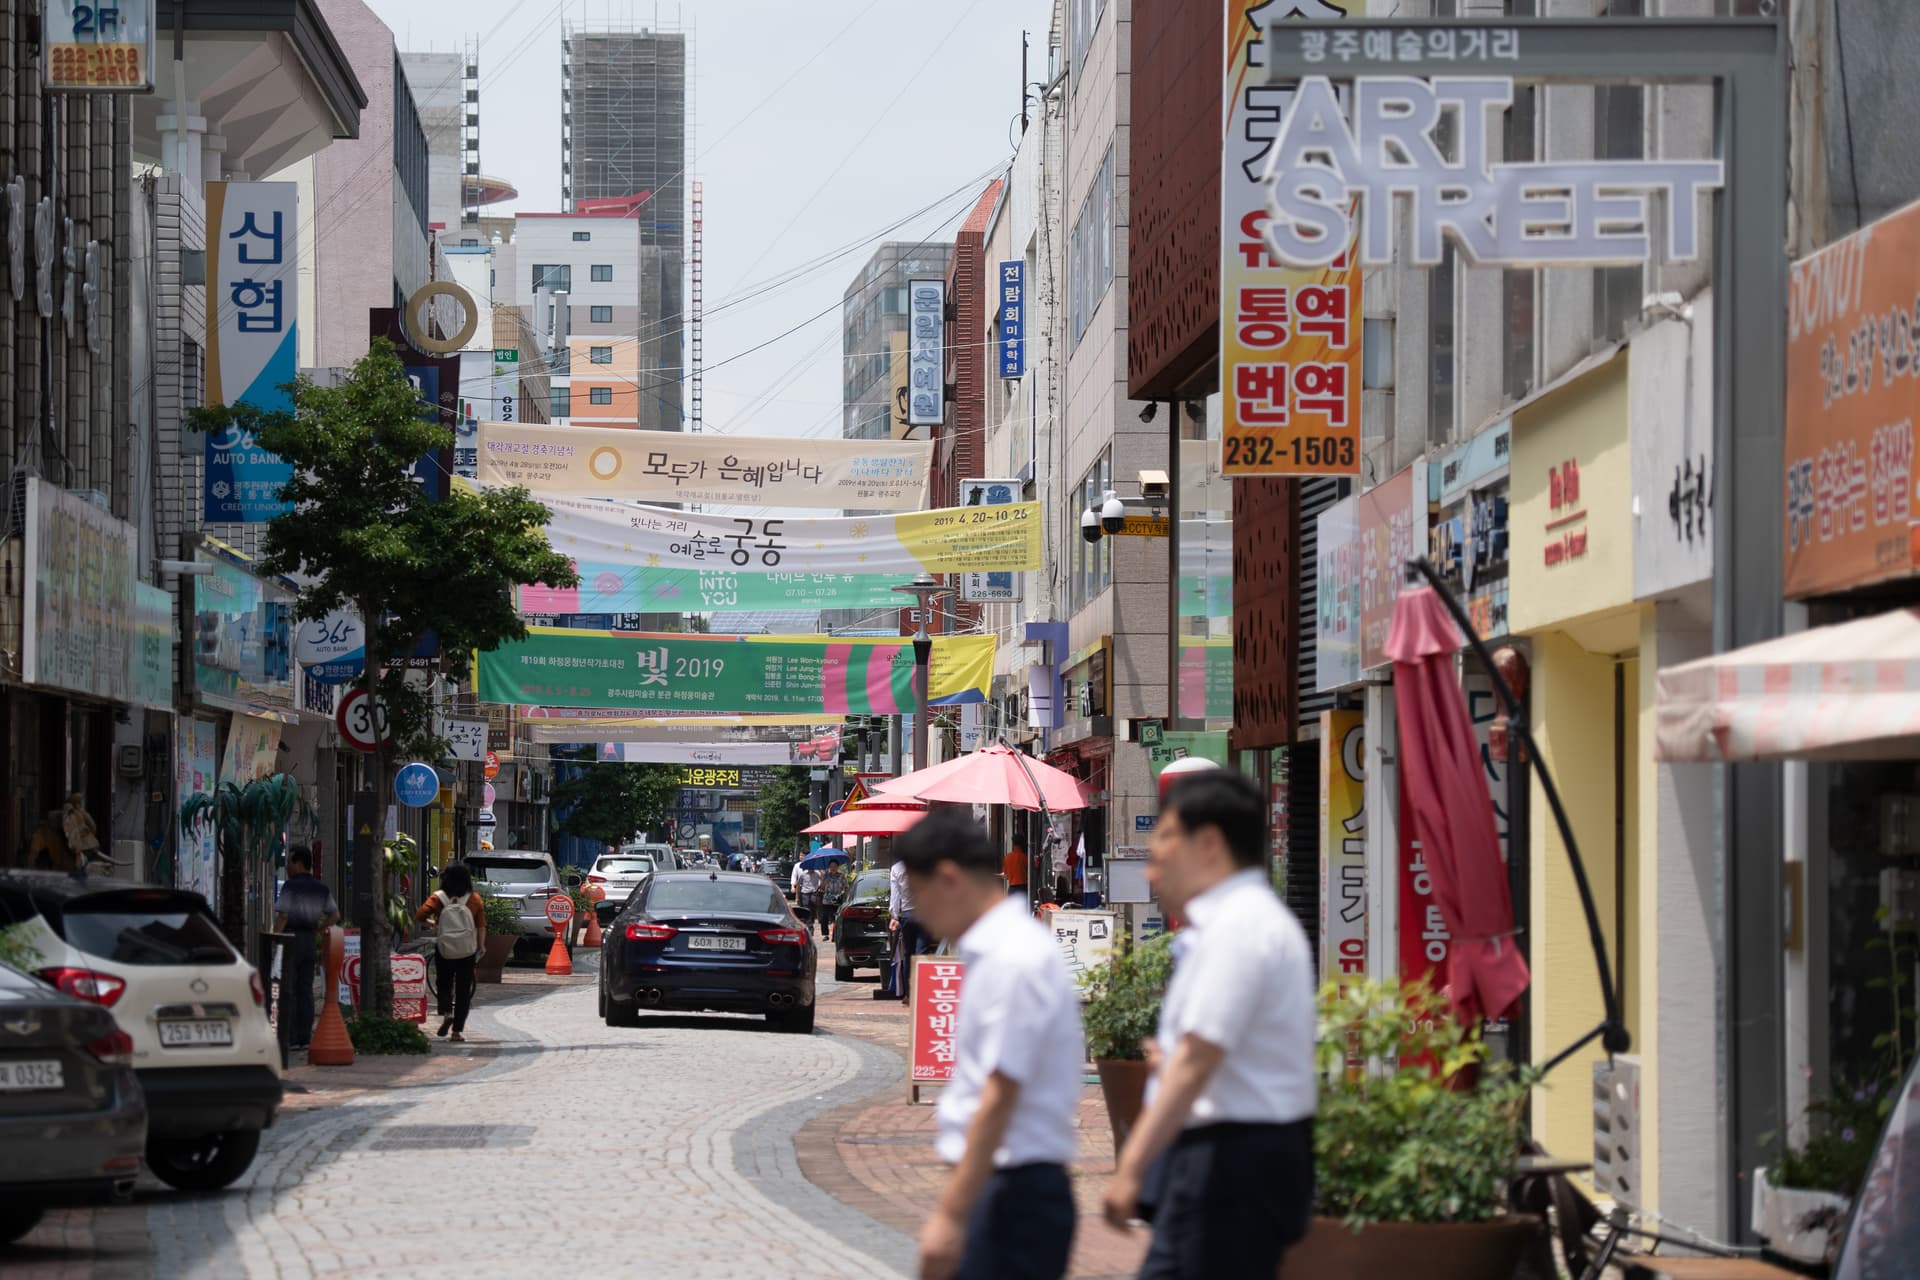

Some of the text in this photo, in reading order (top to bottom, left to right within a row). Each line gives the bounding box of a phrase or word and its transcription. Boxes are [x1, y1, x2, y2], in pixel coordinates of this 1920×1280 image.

[73, 5, 119, 33] 2F
[53, 48, 138, 64] 222-1138
[1301, 28, 1520, 61] 광주예술의거리
[53, 65, 139, 81] 222-2510
[1264, 76, 1514, 178] ART
[1264, 159, 1725, 267] STREET
[229, 211, 282, 333] 신협
[1789, 232, 1872, 341] DONUT
[1004, 266, 1021, 322] 전람회
[1238, 287, 1346, 347] 통역
[502, 396, 513, 422] 062
[1236, 365, 1346, 424] 번역
[213, 453, 283, 465] AUTO BANK
[1226, 436, 1355, 466] 232-1503
[642, 452, 823, 488] 모두가 은혜입니다
[220, 503, 286, 512] CREDIT UNION
[934, 517, 954, 526] 2019
[630, 516, 688, 532] 빛나는 거리
[669, 518, 787, 566] 예술로 궁동
[700, 577, 738, 590] INTO
[700, 591, 738, 606] YOU
[308, 619, 356, 645] 365
[636, 646, 724, 687] 빛 2019
[717, 938, 740, 948] 1821
[929, 964, 963, 1063] 무등반점
